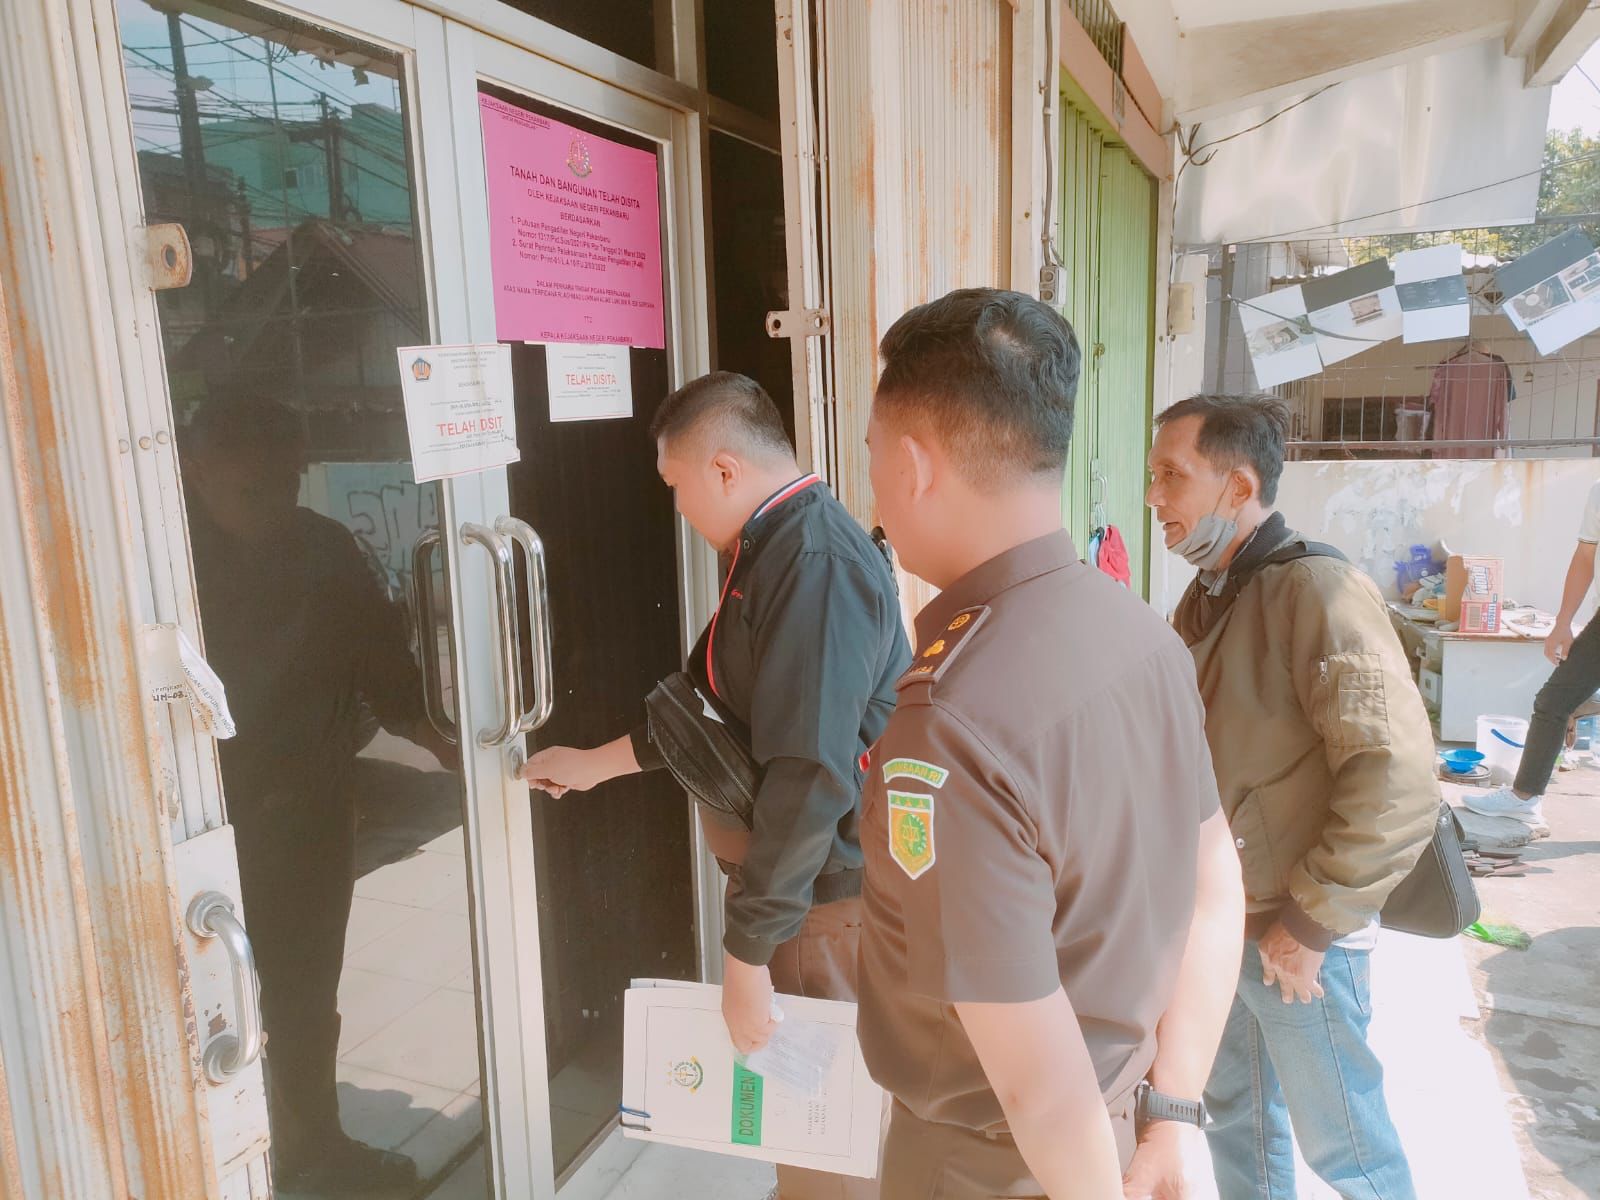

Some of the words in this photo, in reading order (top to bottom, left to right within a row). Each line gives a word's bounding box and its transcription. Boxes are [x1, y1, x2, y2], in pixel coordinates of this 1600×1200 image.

[509, 164, 537, 183] TANAH
[539, 172, 555, 188] DAN
[556, 177, 597, 199] BANGUNAN
[598, 188, 619, 204] TELAH
[620, 194, 640, 209] DISITA
[527, 188, 544, 200] OLEH
[545, 192, 578, 208] KEJAKSAAN
[579, 201, 598, 213] NEGERI
[599, 205, 629, 220] PEKANBARU
[511, 215, 516, 224] 1.
[517, 216, 539, 229] Putusan
[559, 211, 600, 227] BERDASARKAN
[512, 237, 517, 246] 2.
[518, 238, 533, 249] Surat
[566, 374, 591, 385] TELAH
[593, 374, 617, 385] DISITA
[435, 420, 476, 437] TELAH
[738, 1075, 755, 1137] DOKUMEN
